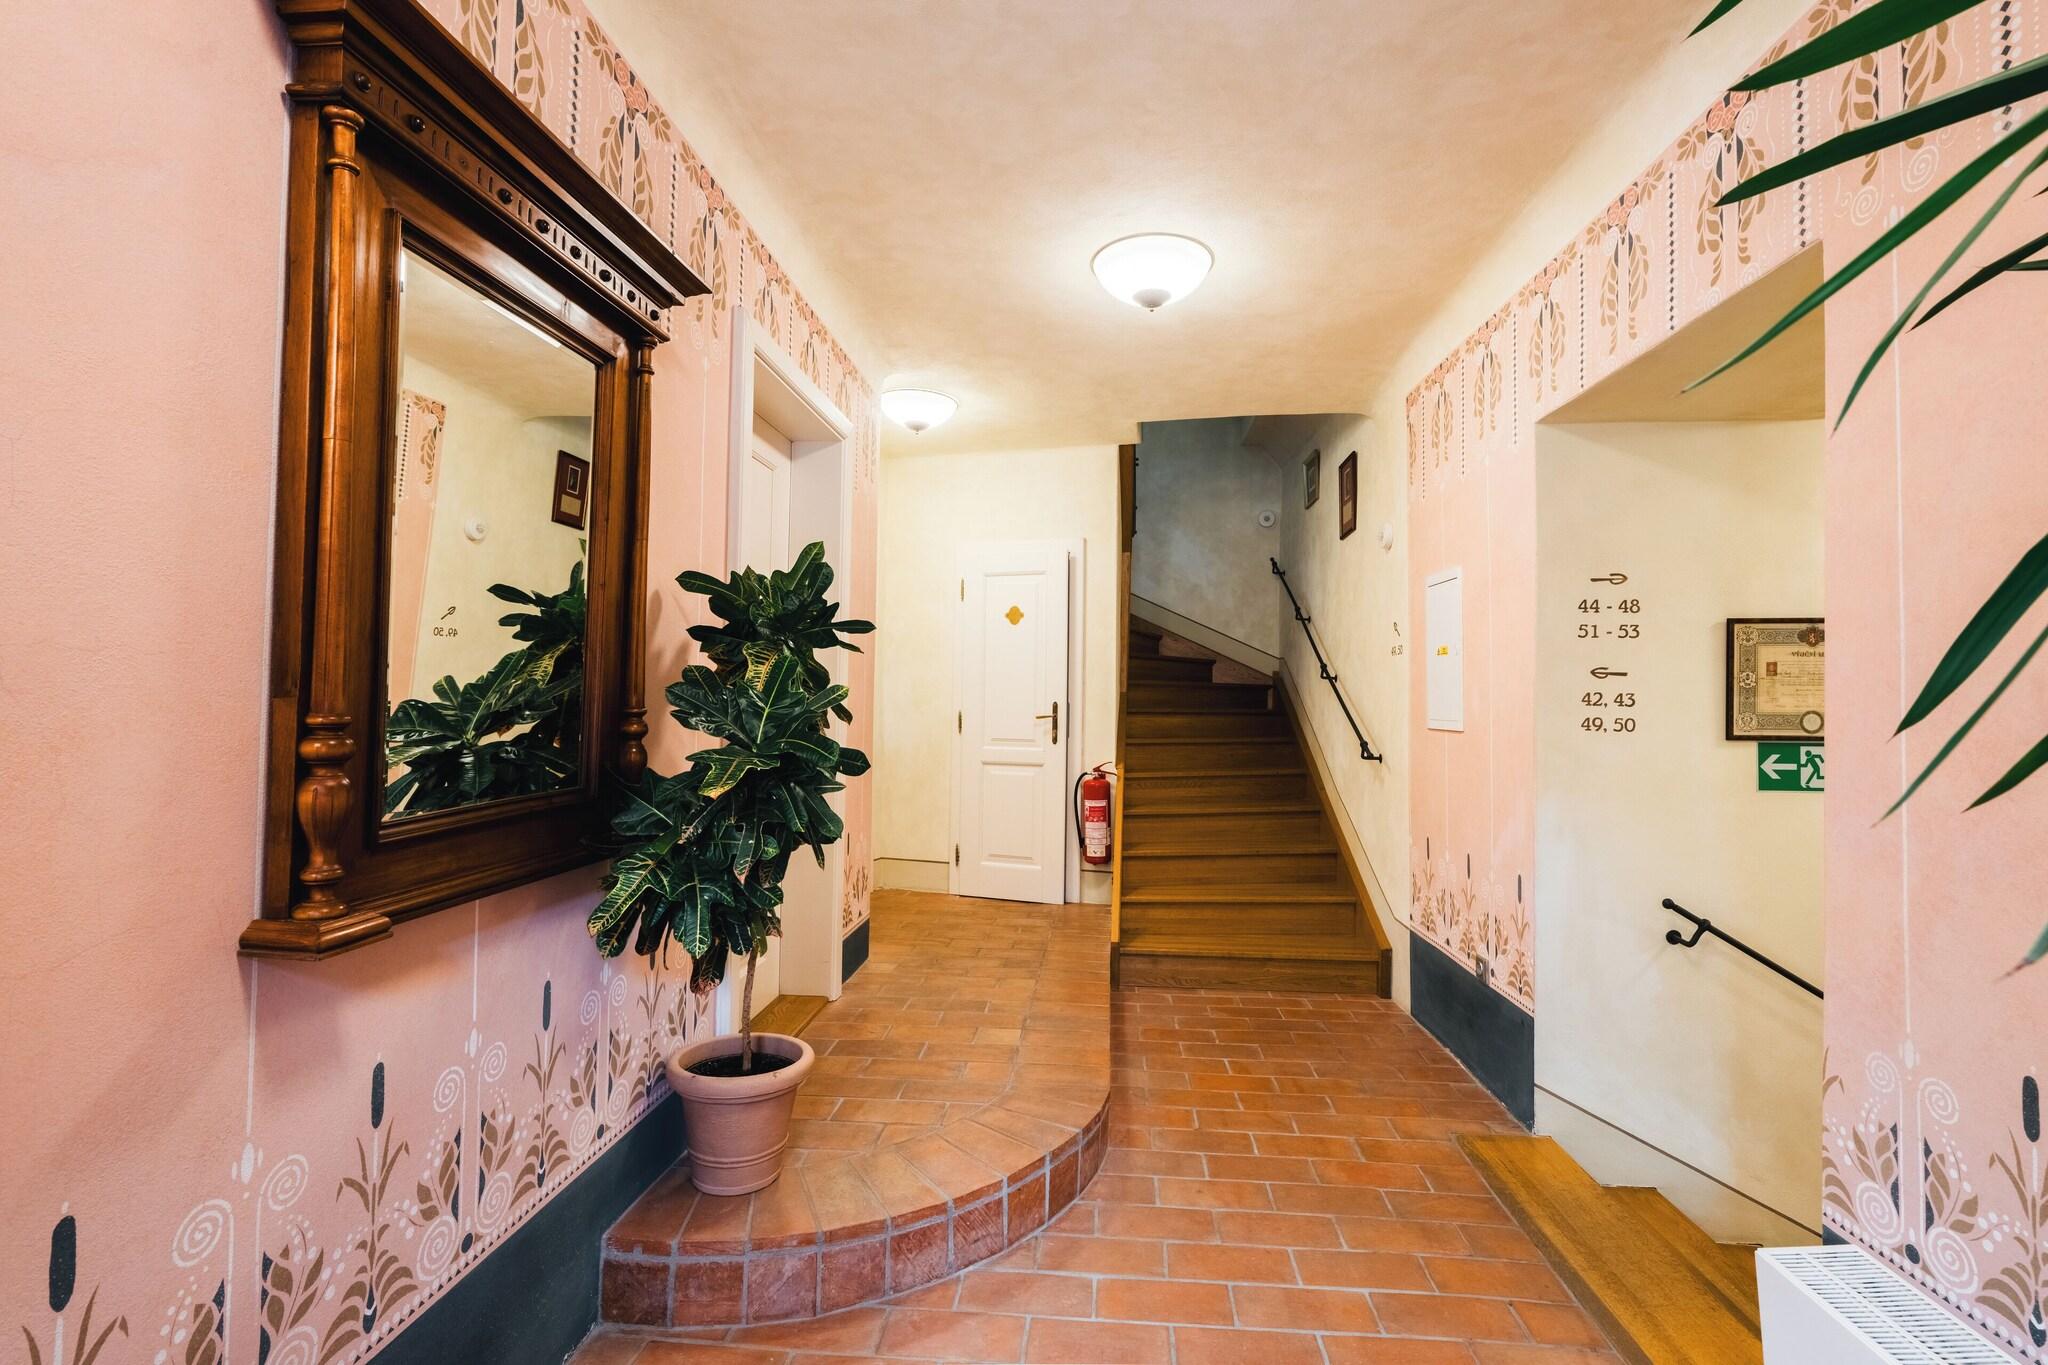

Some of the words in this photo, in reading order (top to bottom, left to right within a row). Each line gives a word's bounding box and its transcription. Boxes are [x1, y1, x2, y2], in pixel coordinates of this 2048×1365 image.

[1578, 599, 1600, 613] 44
[1618, 599, 1640, 613] 48
[1578, 624, 1599, 638] 51
[1618, 624, 1640, 639] 53
[1581, 692, 1607, 708] 42,
[1614, 693, 1635, 707] 43
[1581, 717, 1607, 733] 49,
[1613, 718, 1636, 732] 50
